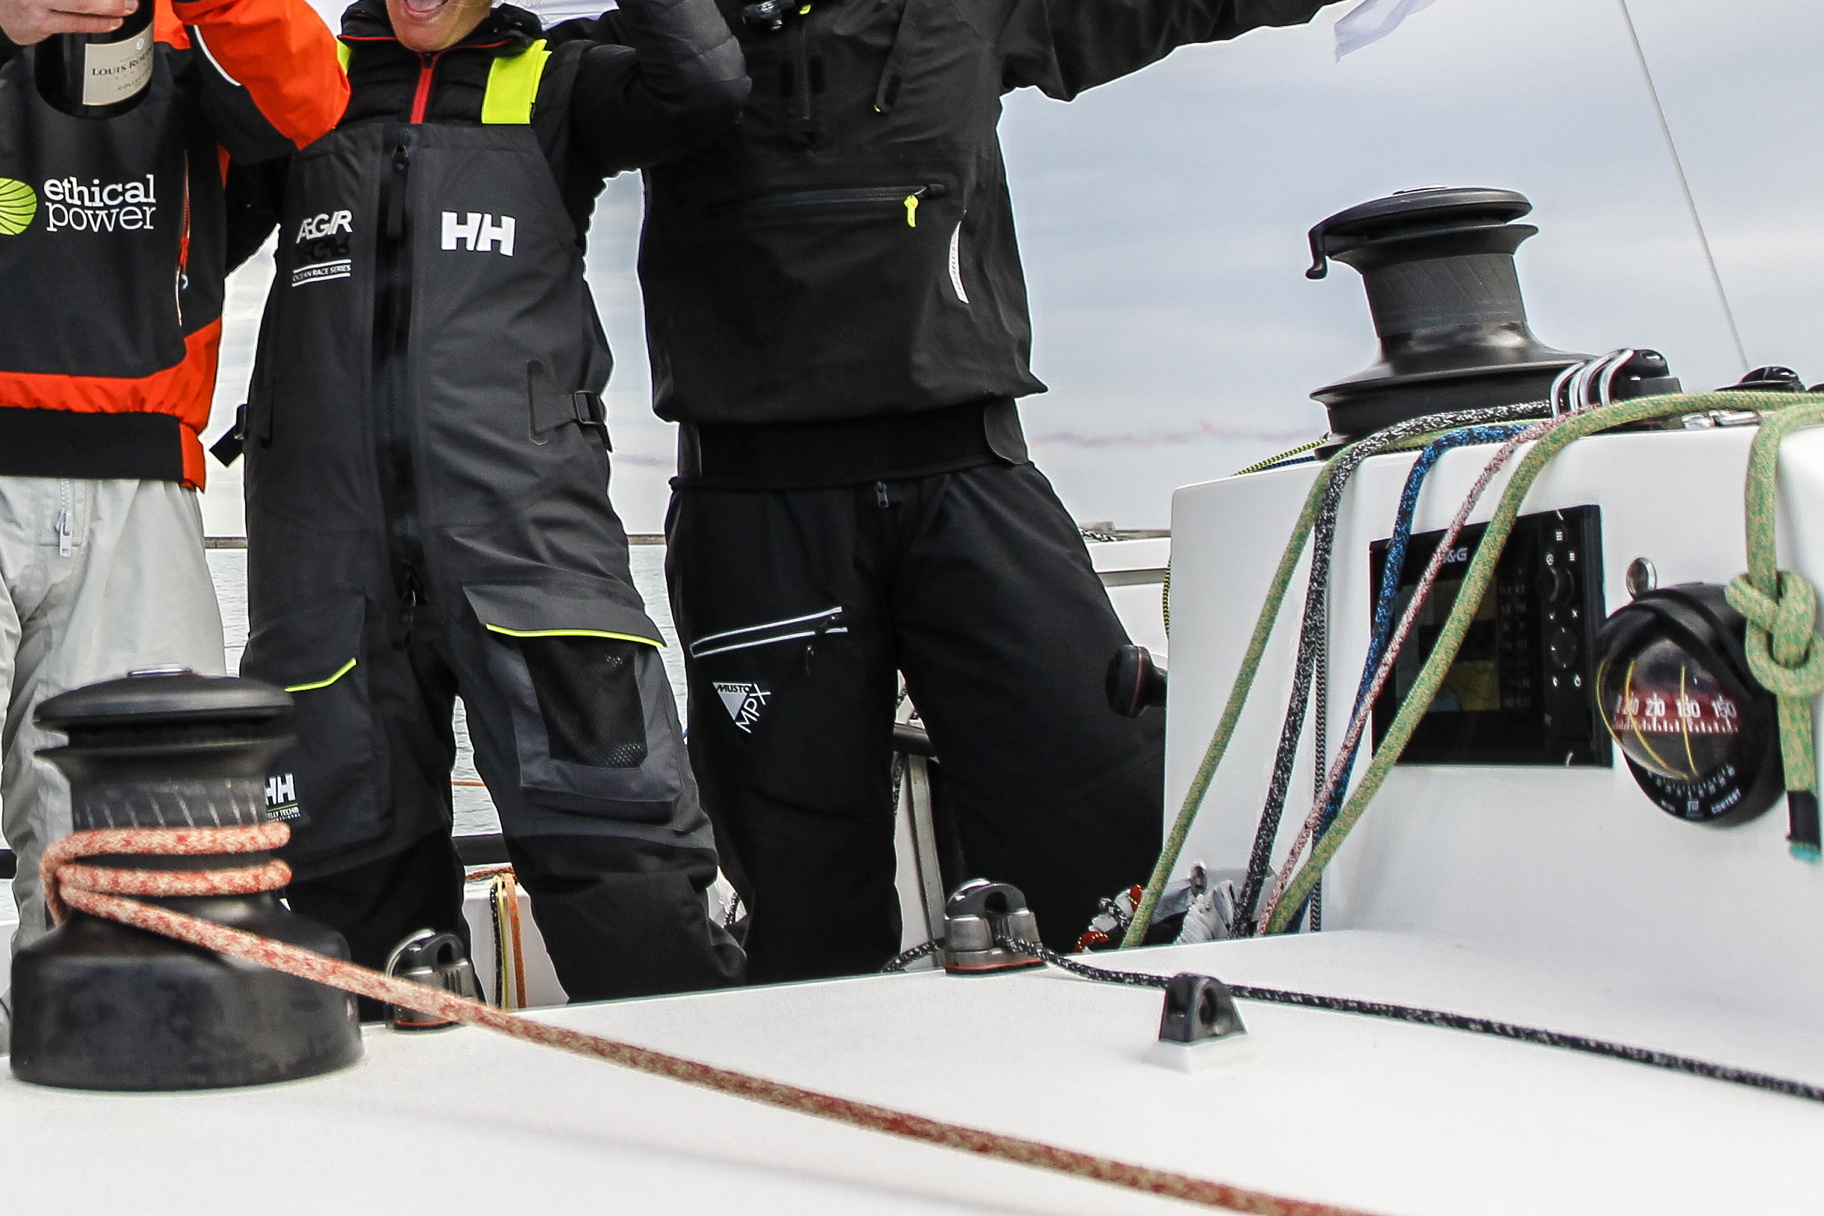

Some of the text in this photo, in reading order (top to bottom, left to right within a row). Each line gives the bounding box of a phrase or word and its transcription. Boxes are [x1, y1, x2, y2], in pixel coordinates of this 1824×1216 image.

[43, 174, 157, 207] ethical
[45, 201, 157, 232] power
[441, 210, 516, 257] HH
[312, 267, 330, 277] RACE
[717, 684, 750, 694] MUSTO
[735, 683, 772, 733] MPX
